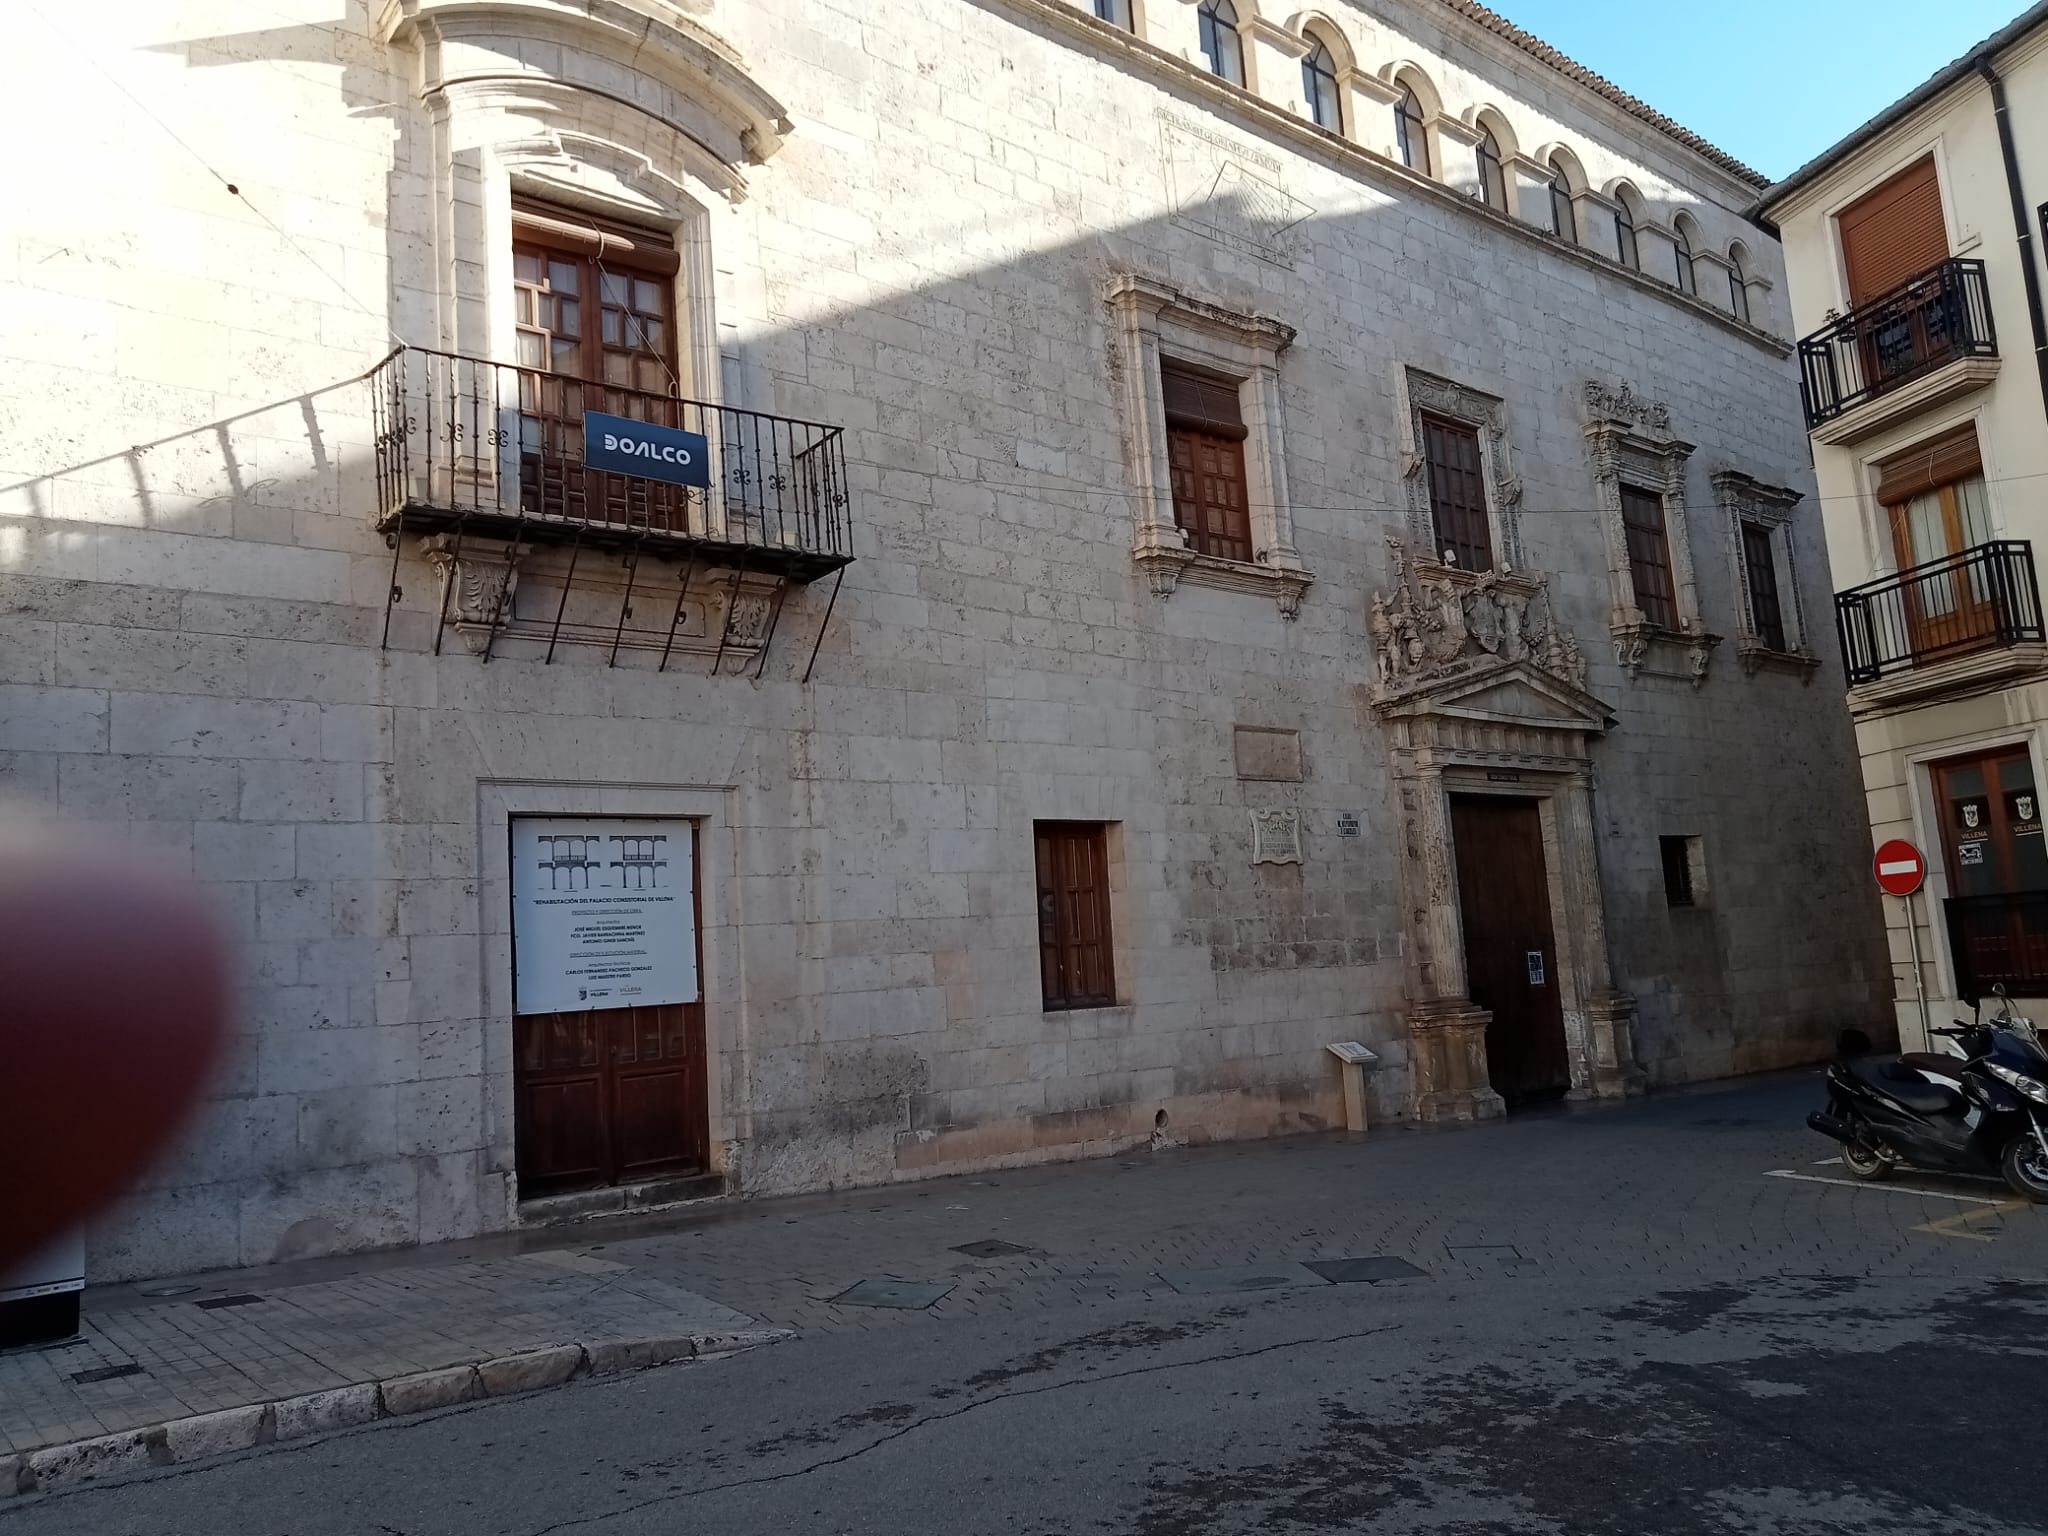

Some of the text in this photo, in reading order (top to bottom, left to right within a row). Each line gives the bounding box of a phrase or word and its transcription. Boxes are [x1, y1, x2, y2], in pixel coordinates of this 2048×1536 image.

[604, 433, 691, 466] DOALCO
[2013, 824, 2042, 833] VILLENA
[1960, 831, 1988, 840] VILLENA
